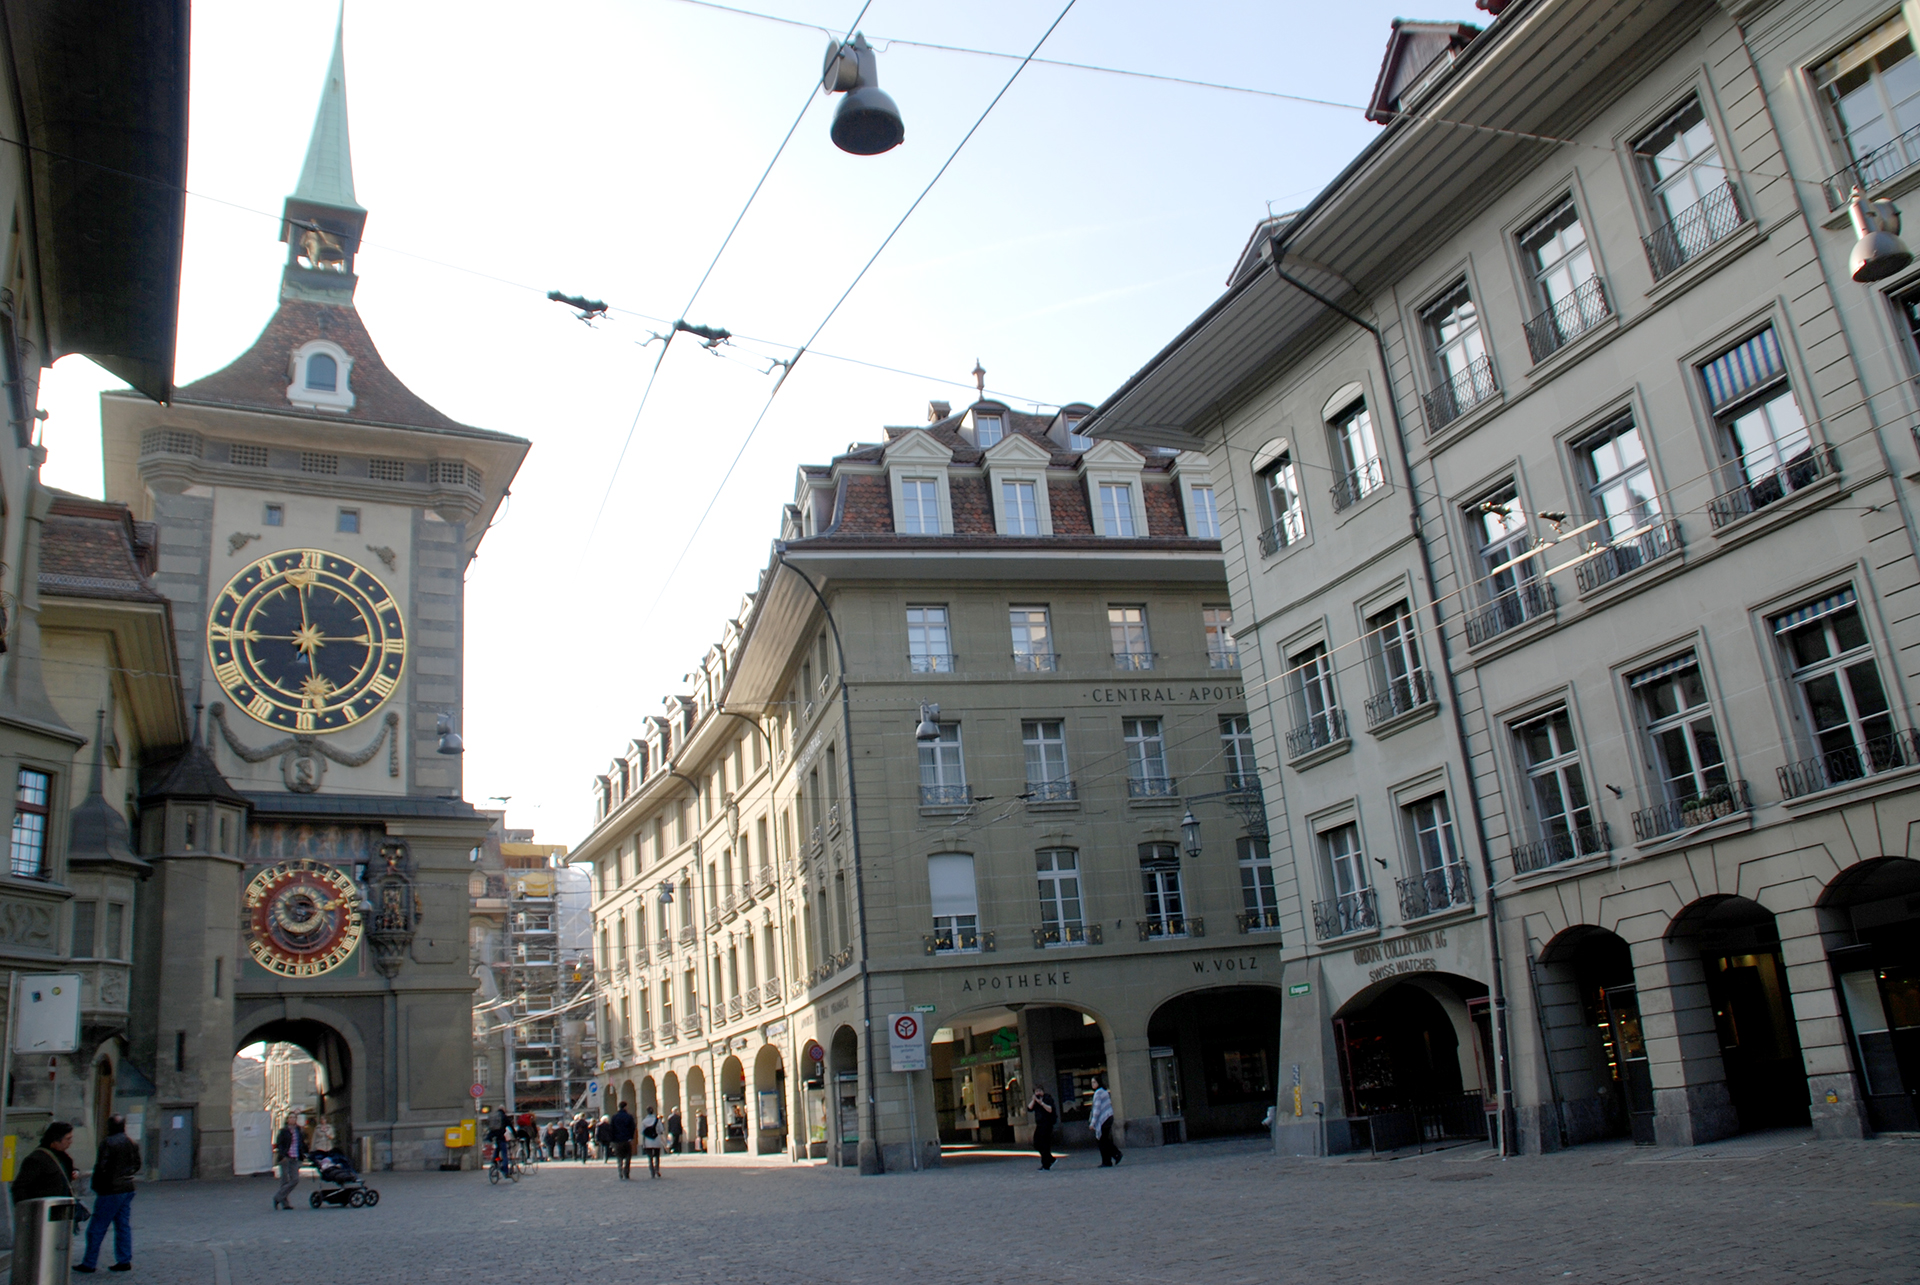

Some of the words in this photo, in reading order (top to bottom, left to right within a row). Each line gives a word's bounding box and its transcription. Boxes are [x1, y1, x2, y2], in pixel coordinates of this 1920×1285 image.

[1092, 687, 1176, 703] CENTRAL
[1384, 932, 1432, 959] COLLECTION
[1435, 930, 1447, 949] AG
[962, 971, 1072, 992] APOTHEKE
[1369, 963, 1395, 983] SWISS
[1396, 958, 1437, 974] WATCHES
